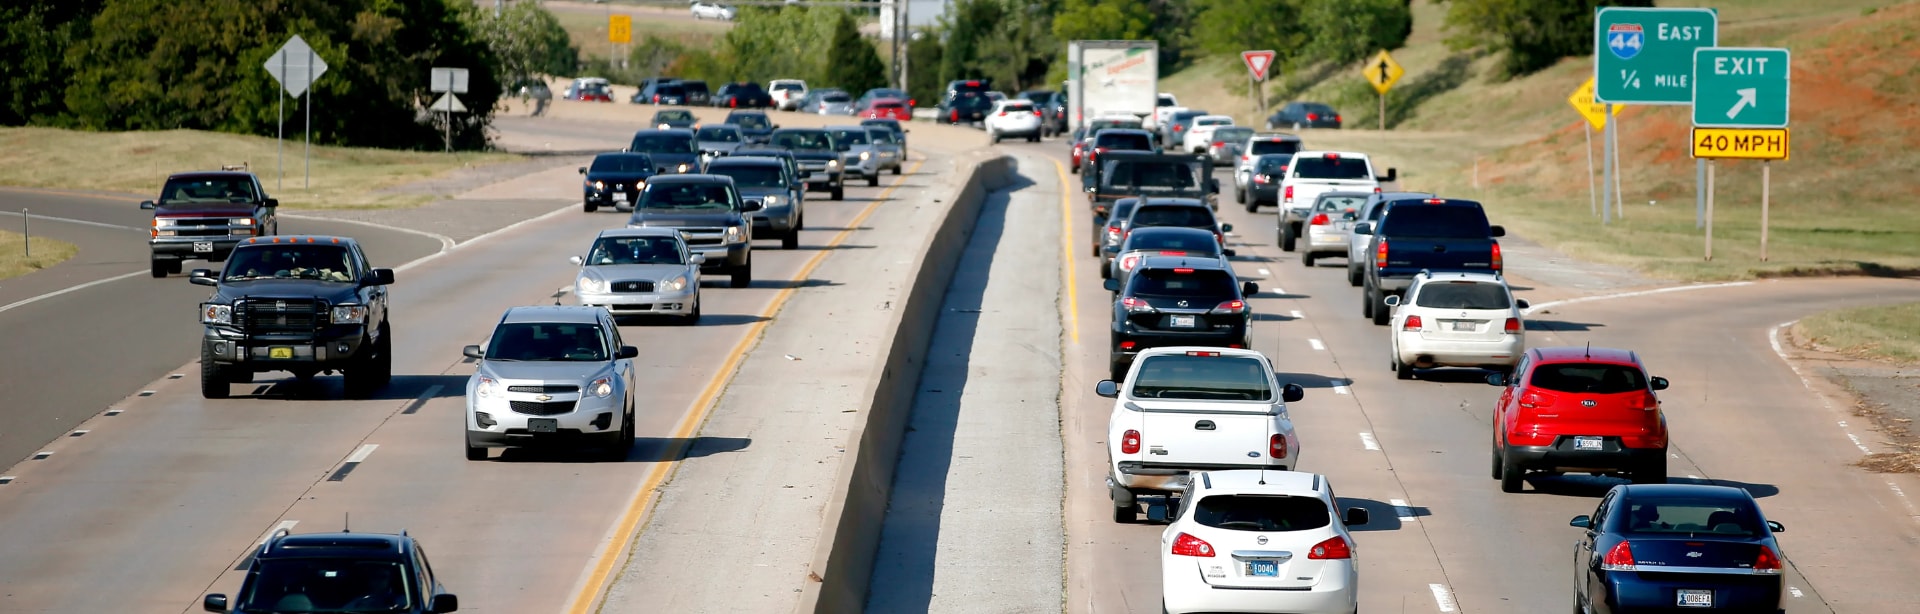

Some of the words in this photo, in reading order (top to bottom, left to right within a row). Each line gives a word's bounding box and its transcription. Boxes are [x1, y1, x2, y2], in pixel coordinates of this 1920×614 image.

[1610, 33, 1641, 50] 44
[1658, 23, 1702, 41] EAST
[1714, 57, 1769, 75] EXIT
[1655, 74, 1688, 88] MILE
[1699, 135, 1729, 152] 40
[1734, 135, 1781, 152] MPH
